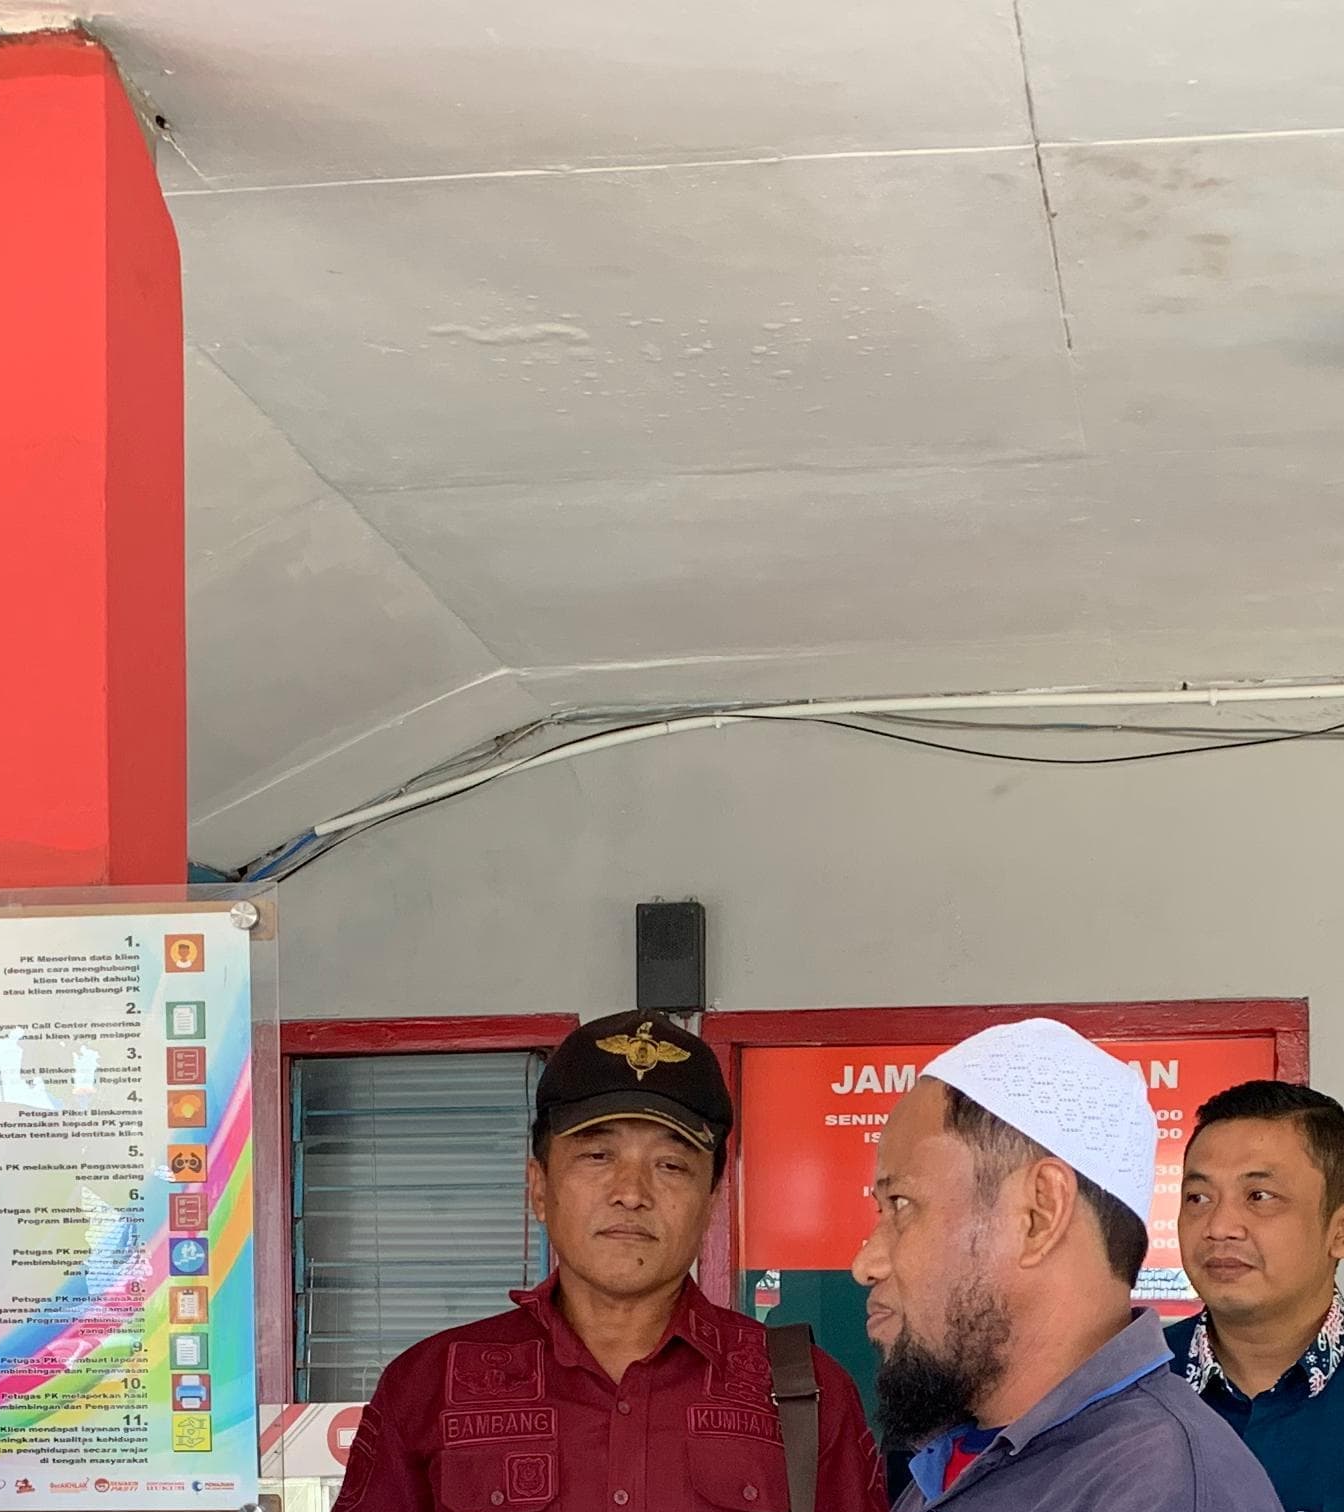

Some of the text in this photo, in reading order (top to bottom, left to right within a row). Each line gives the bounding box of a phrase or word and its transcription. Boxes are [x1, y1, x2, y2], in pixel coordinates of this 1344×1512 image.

[125, 935, 141, 948] 1.
[20, 952, 140, 963] PK Menerima data klien
[72, 964, 140, 974] menghubungi
[33, 976, 57, 984] klien
[60, 975, 100, 984] terlebih
[3, 985, 141, 996] atau klien menghubungi PK
[126, 1002, 142, 1015] 2.
[32, 1022, 51, 1030] Call
[54, 1021, 88, 1030] Center
[91, 1020, 141, 1029] menerima
[46, 1033, 71, 1041] klien
[73, 1032, 97, 1041] yang
[100, 1031, 141, 1041] melapor
[126, 1047, 142, 1060] 3.
[99, 1076, 142, 1086] Register
[831, 1064, 915, 1094] JAM
[127, 1090, 143, 1103] 4.
[18, 1110, 59, 1119] Petugas
[62, 1120, 99, 1129] kepada
[101, 1119, 116, 1127] PK
[119, 1119, 144, 1129] yang
[30, 1131, 69, 1140] tentang
[71, 1130, 116, 1138] identitas
[128, 1144, 144, 1157] 5.
[5, 1163, 20, 1172] PK
[23, 1163, 78, 1171] melakukan
[80, 1162, 144, 1171] Pengawasan
[112, 1173, 145, 1182] daring
[129, 1188, 145, 1201] 6.
[34, 1206, 49, 1214] PK
[17, 1217, 60, 1226] Program
[13, 1248, 53, 1257] Petugas
[56, 1248, 70, 1256] PK
[131, 1280, 146, 1293] 8.
[12, 1295, 52, 1304] Petugas
[55, 1295, 69, 1303] PK
[26, 1316, 69, 1326] Program
[132, 1340, 148, 1353] 9.
[0, 1357, 41, 1366] Petugas
[43, 1356, 57, 1365] PK
[64, 1367, 83, 1375] dan
[121, 1377, 147, 1390] 10.
[1, 1392, 41, 1402] Petugas
[44, 1392, 58, 1400] PK
[61, 1392, 121, 1401] melaporkan
[63, 1402, 82, 1411] dan
[122, 1413, 148, 1426] 11.
[0, 1425, 148, 1434] Klien mendapat layanan guna
[447, 1412, 549, 1438] BAMBANG
[96, 1435, 148, 1444] kehidupan
[16, 1446, 81, 1455] penghidupan
[120, 1446, 148, 1455] wajar
[40, 1457, 149, 1466] di tengah masyarakat
